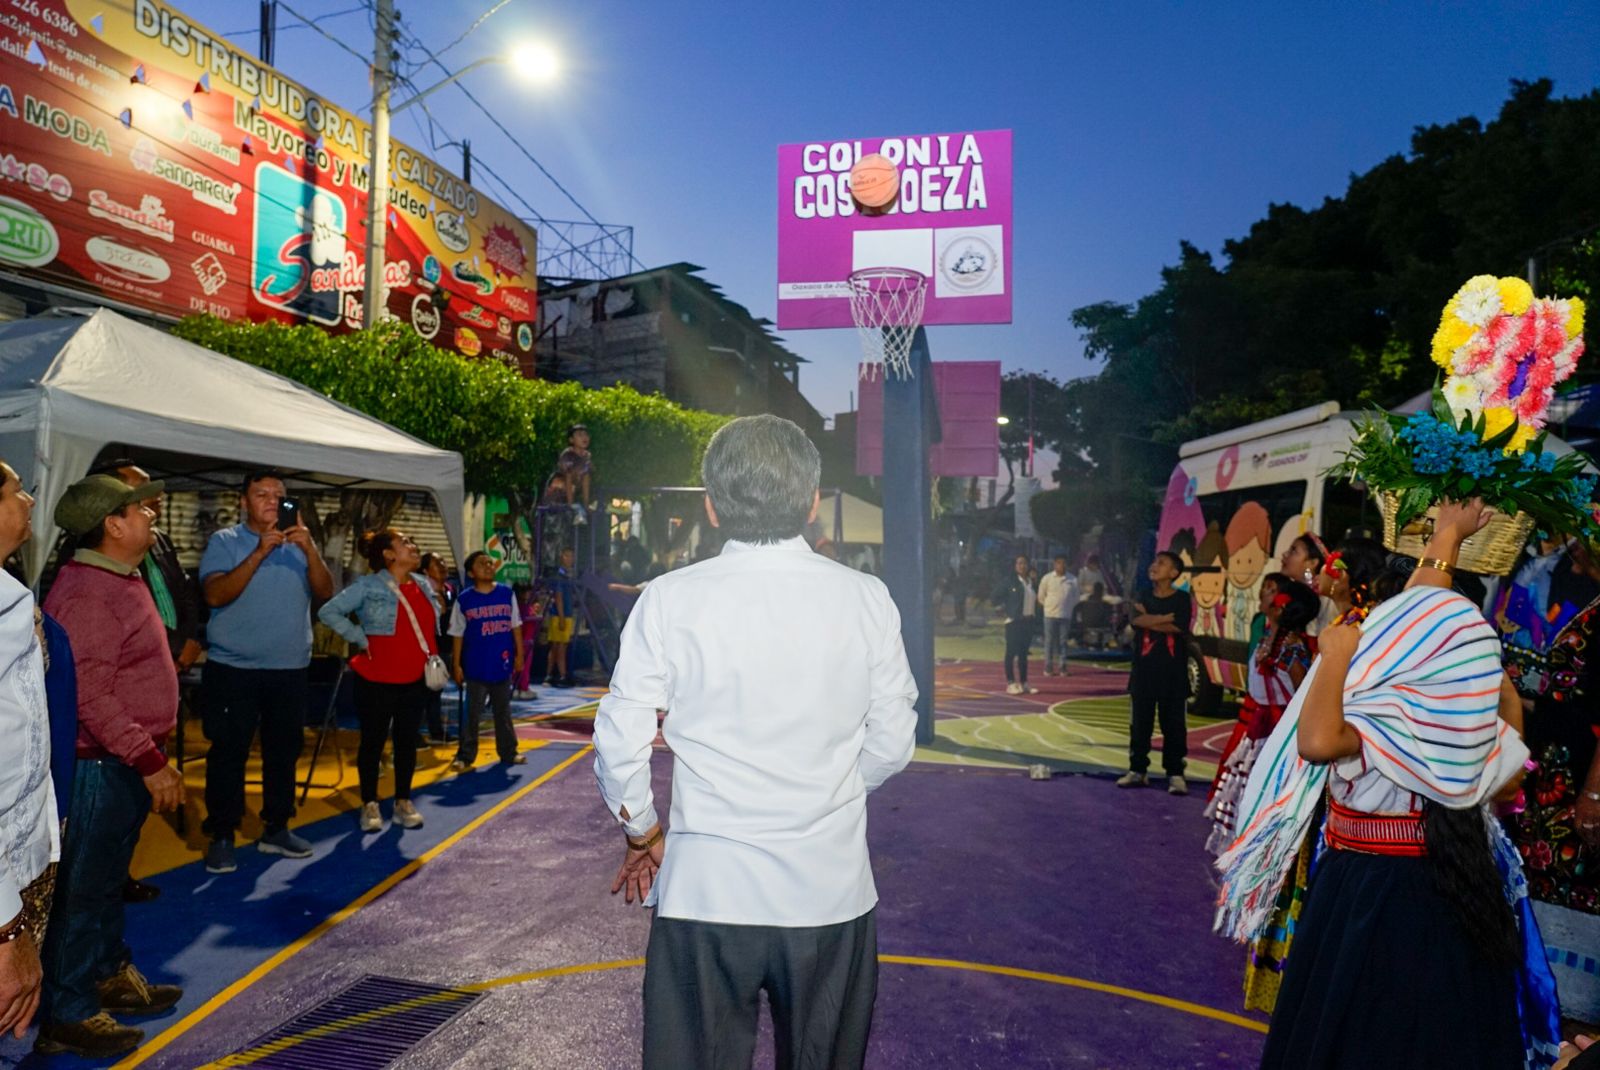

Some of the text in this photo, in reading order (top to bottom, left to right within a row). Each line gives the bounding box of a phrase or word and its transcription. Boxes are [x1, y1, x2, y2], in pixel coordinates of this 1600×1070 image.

[42, 8, 78, 37] 6386
[25, 95, 112, 157] MODA
[135, 0, 360, 155] DISTRIBUIDORA
[396, 149, 478, 218] CALZADO
[235, 96, 428, 220] Mayoreo y Mudeo
[795, 164, 988, 219] COSOEZA
[191, 231, 236, 256] GUARSA
[190, 297, 232, 320] DE RIO
